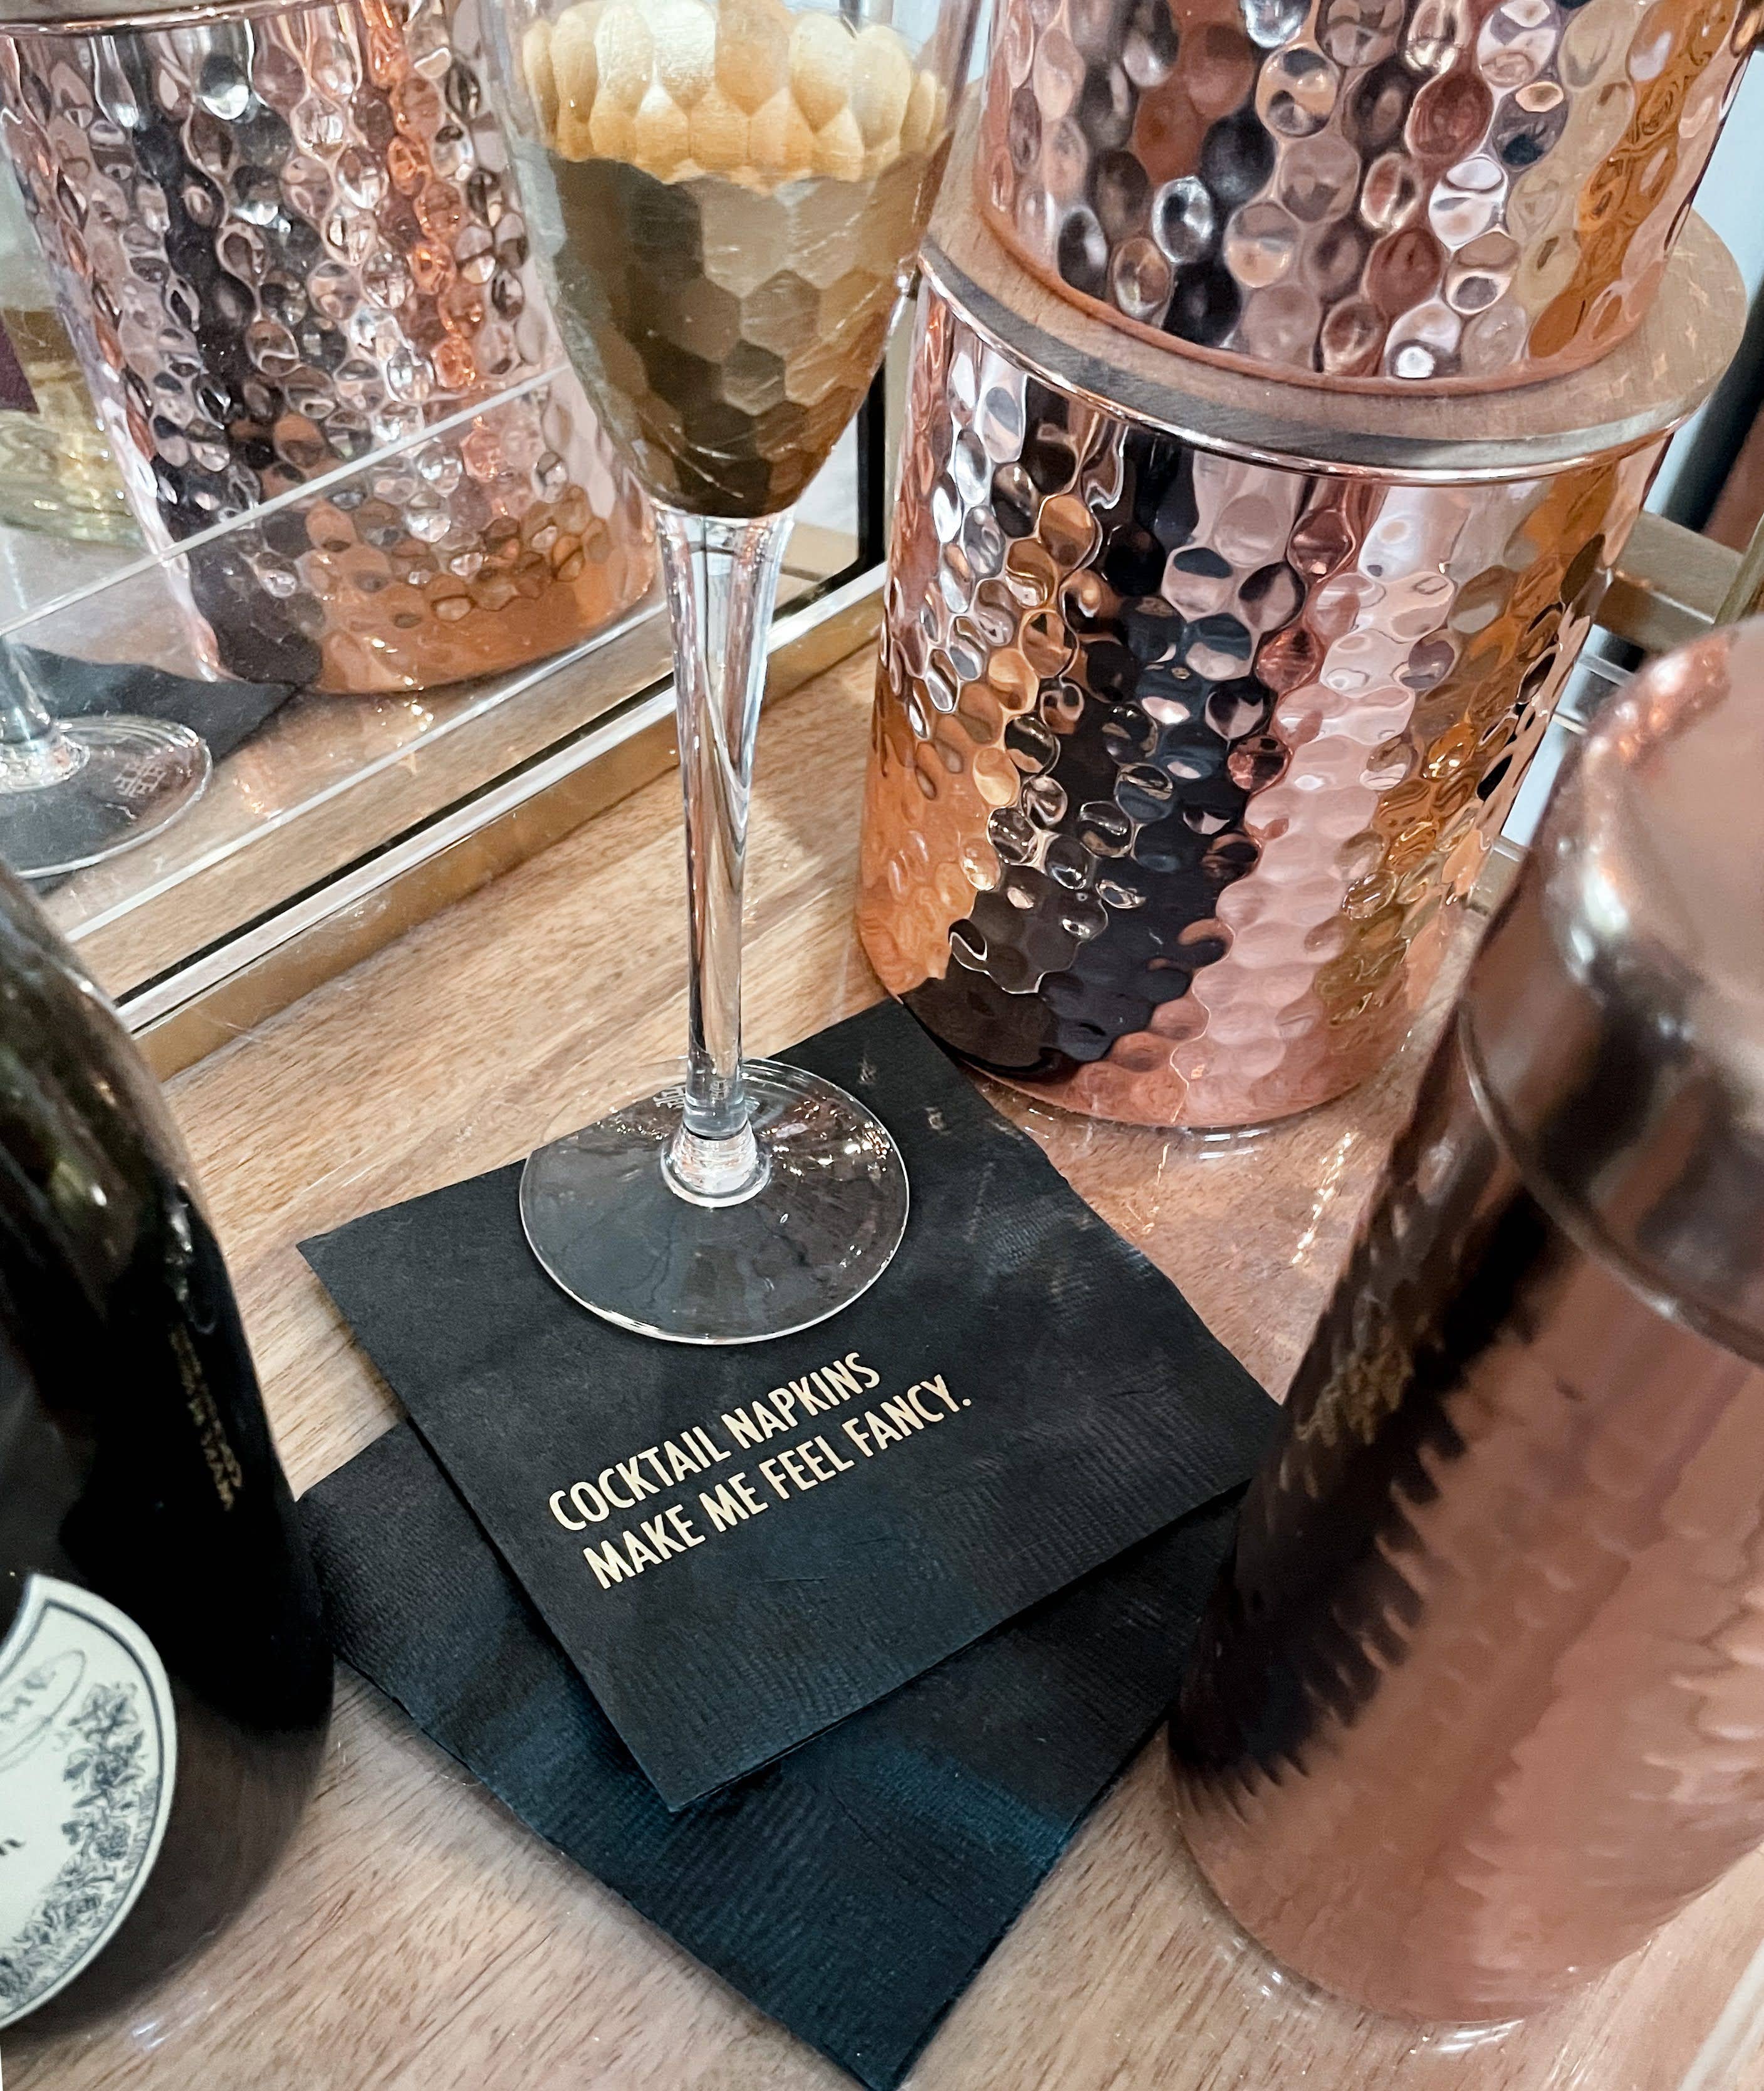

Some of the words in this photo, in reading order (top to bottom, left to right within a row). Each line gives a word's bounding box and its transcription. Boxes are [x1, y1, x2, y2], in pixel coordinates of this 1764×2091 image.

[549, 1426, 732, 1531] COCKTAIL
[721, 1352, 880, 1449] NAPKINS
[583, 1504, 706, 1590] MAKE
[698, 1472, 769, 1533] ME
[758, 1435, 856, 1501] FEEL
[842, 1374, 972, 1458] FANCY.
